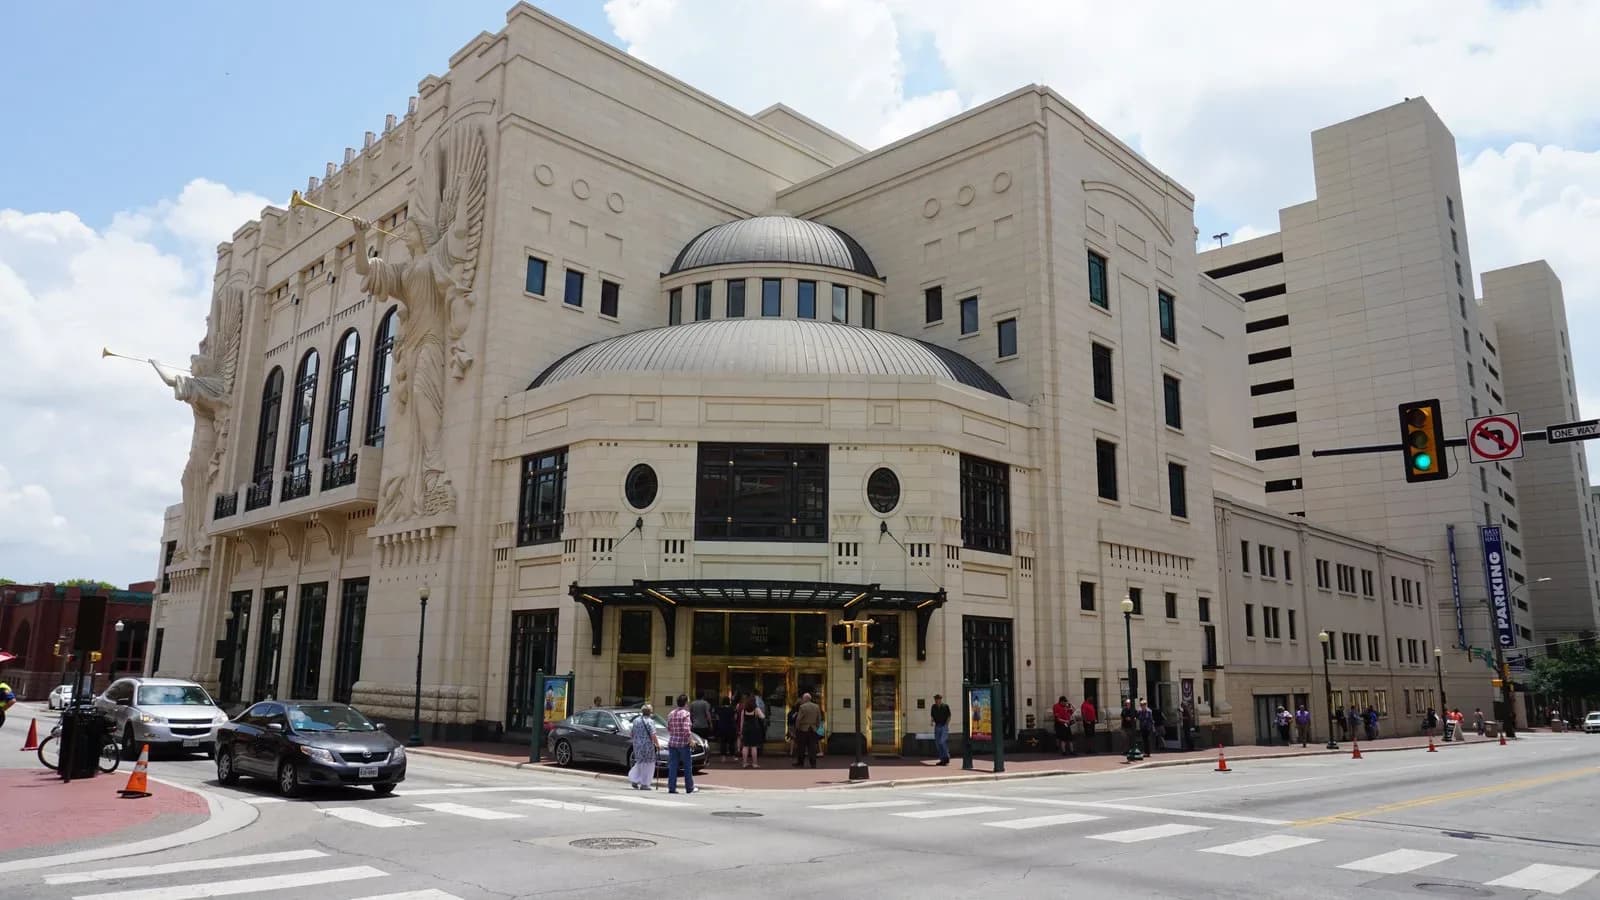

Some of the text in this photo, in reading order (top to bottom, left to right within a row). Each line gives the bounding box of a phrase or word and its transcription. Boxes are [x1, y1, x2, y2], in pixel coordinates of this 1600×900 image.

[1554, 425, 1596, 438] ONE WAY
[1489, 551, 1509, 629] PARKING
